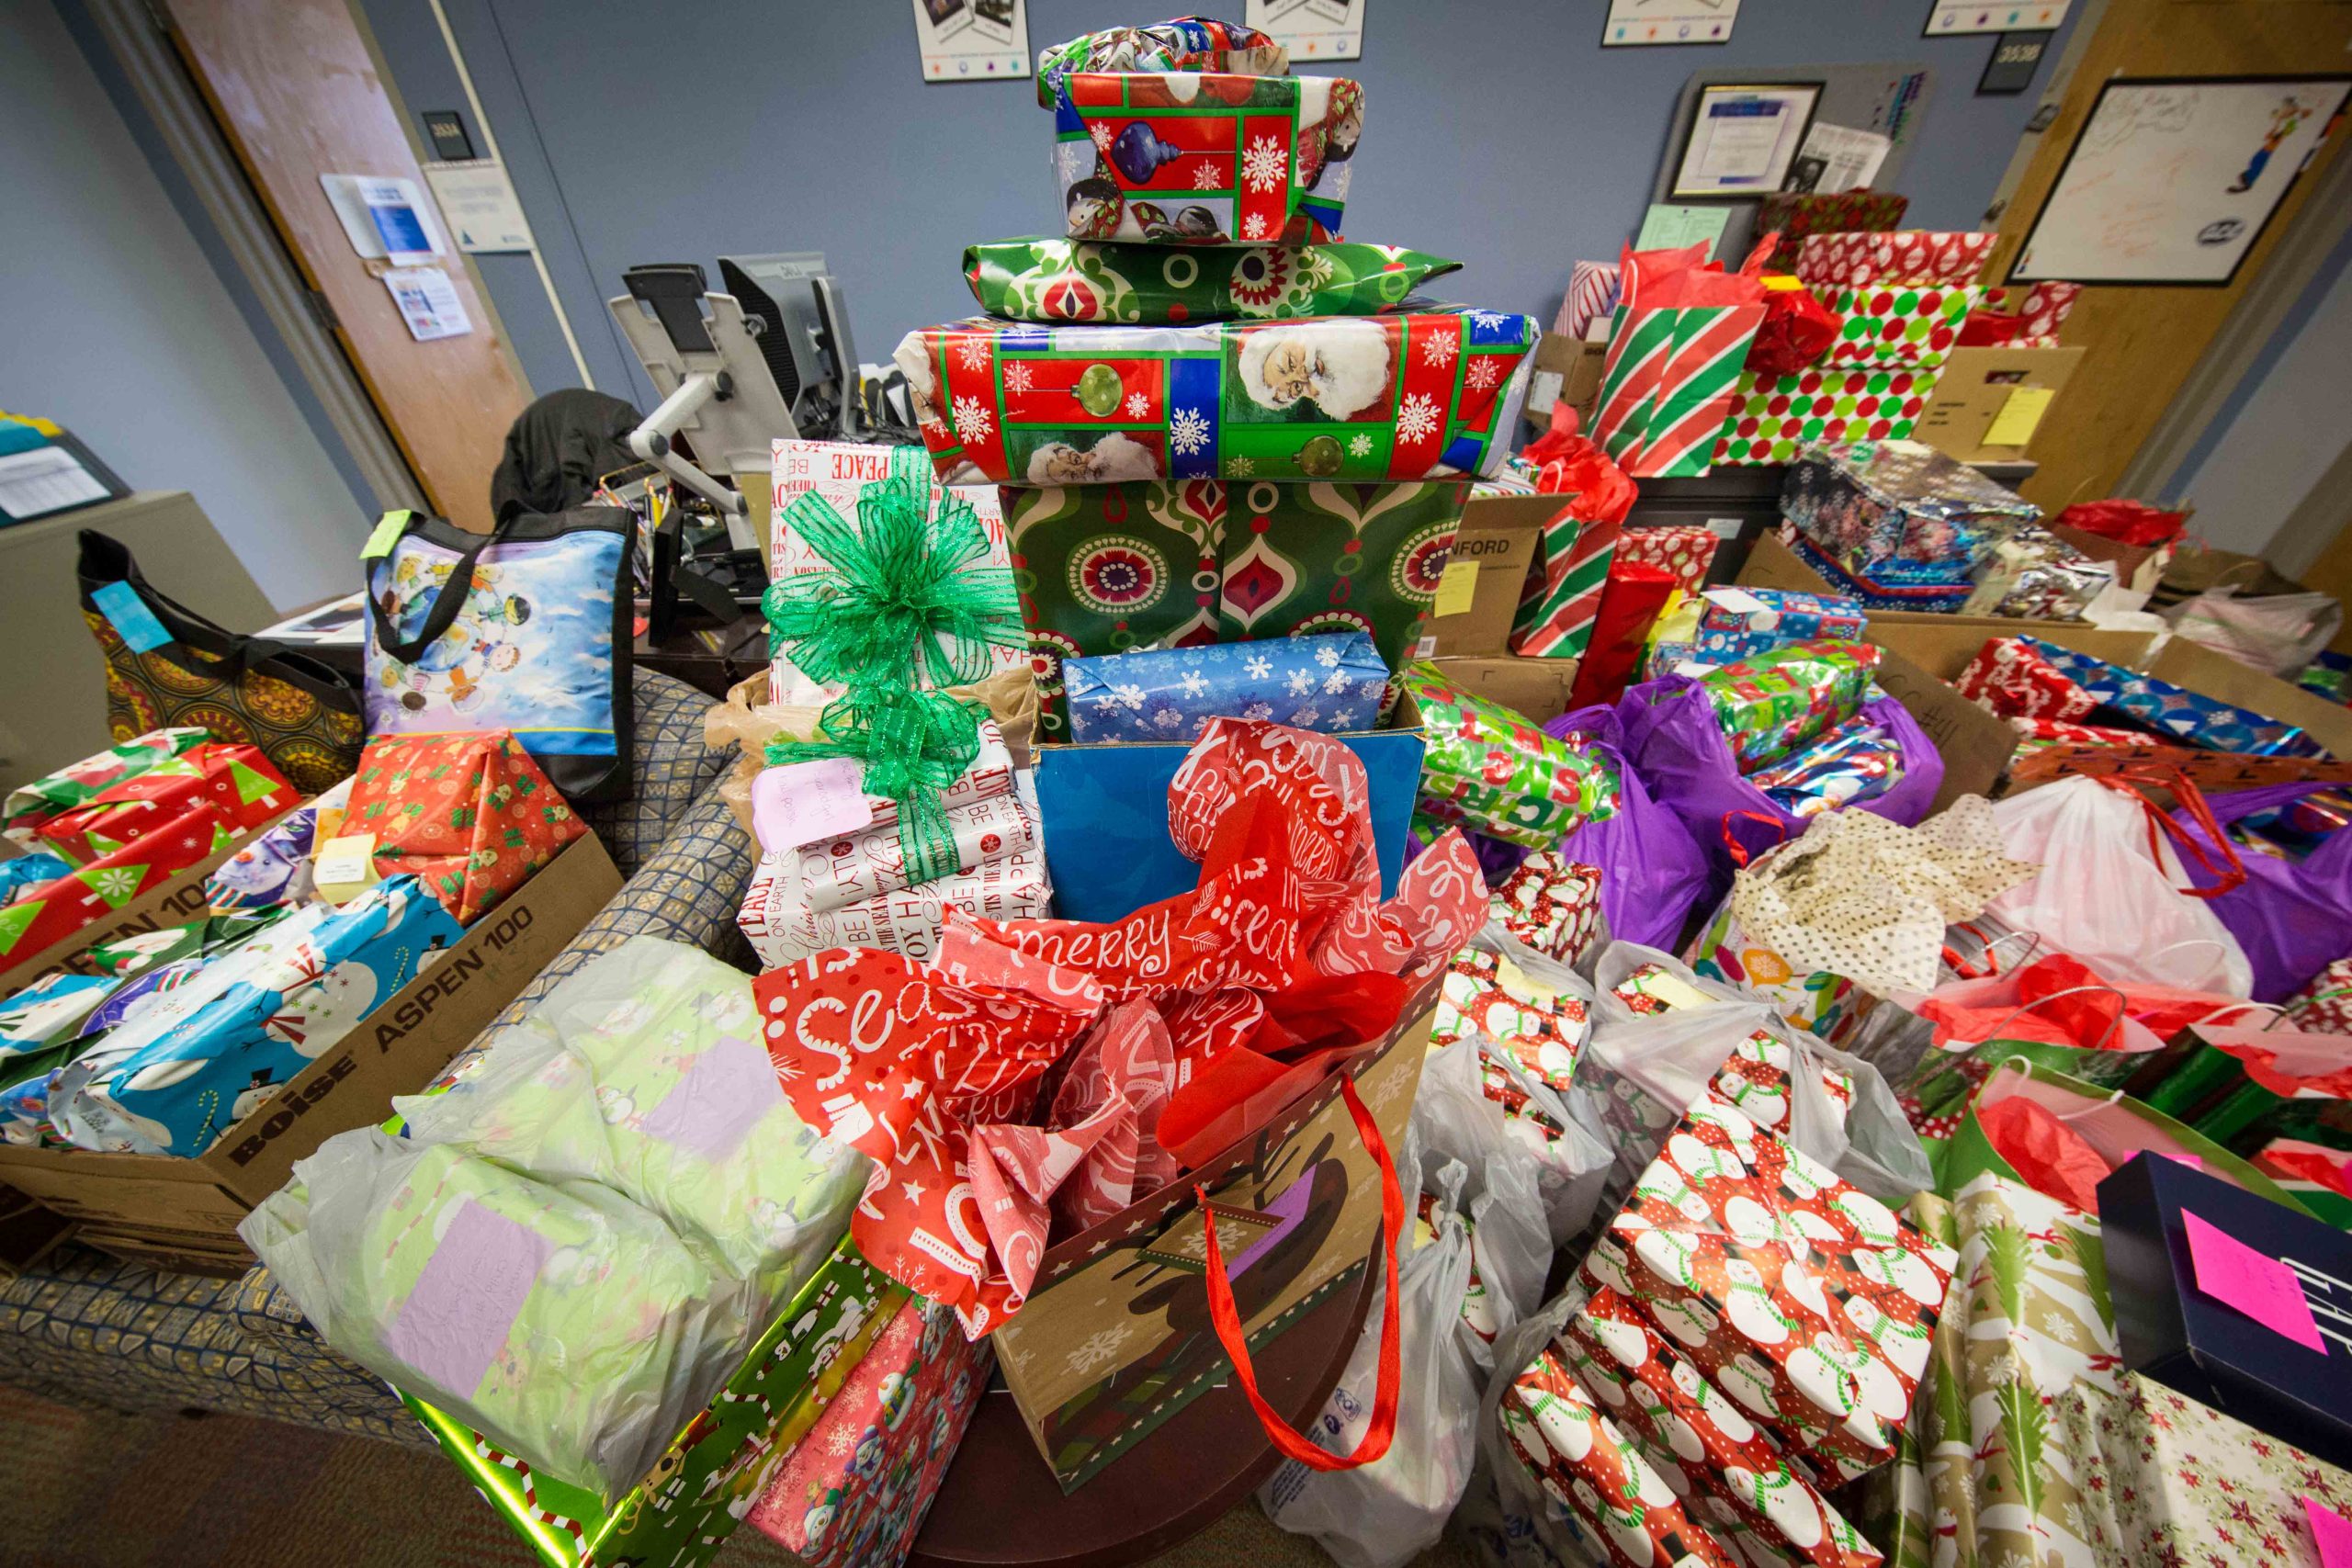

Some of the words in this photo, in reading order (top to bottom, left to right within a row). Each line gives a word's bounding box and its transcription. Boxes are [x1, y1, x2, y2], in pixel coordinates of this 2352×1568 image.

[831, 454, 889, 480] PEACE
[1452, 539, 1510, 556] NFORD
[971, 763, 1011, 799] ACE
[968, 804, 994, 826] BE
[161, 871, 209, 917] 10
[768, 875, 789, 913] EARTH
[771, 917, 786, 938] ON
[842, 919, 870, 943] BE
[374, 946, 485, 1055] ASPEN
[482, 904, 535, 952] 100
